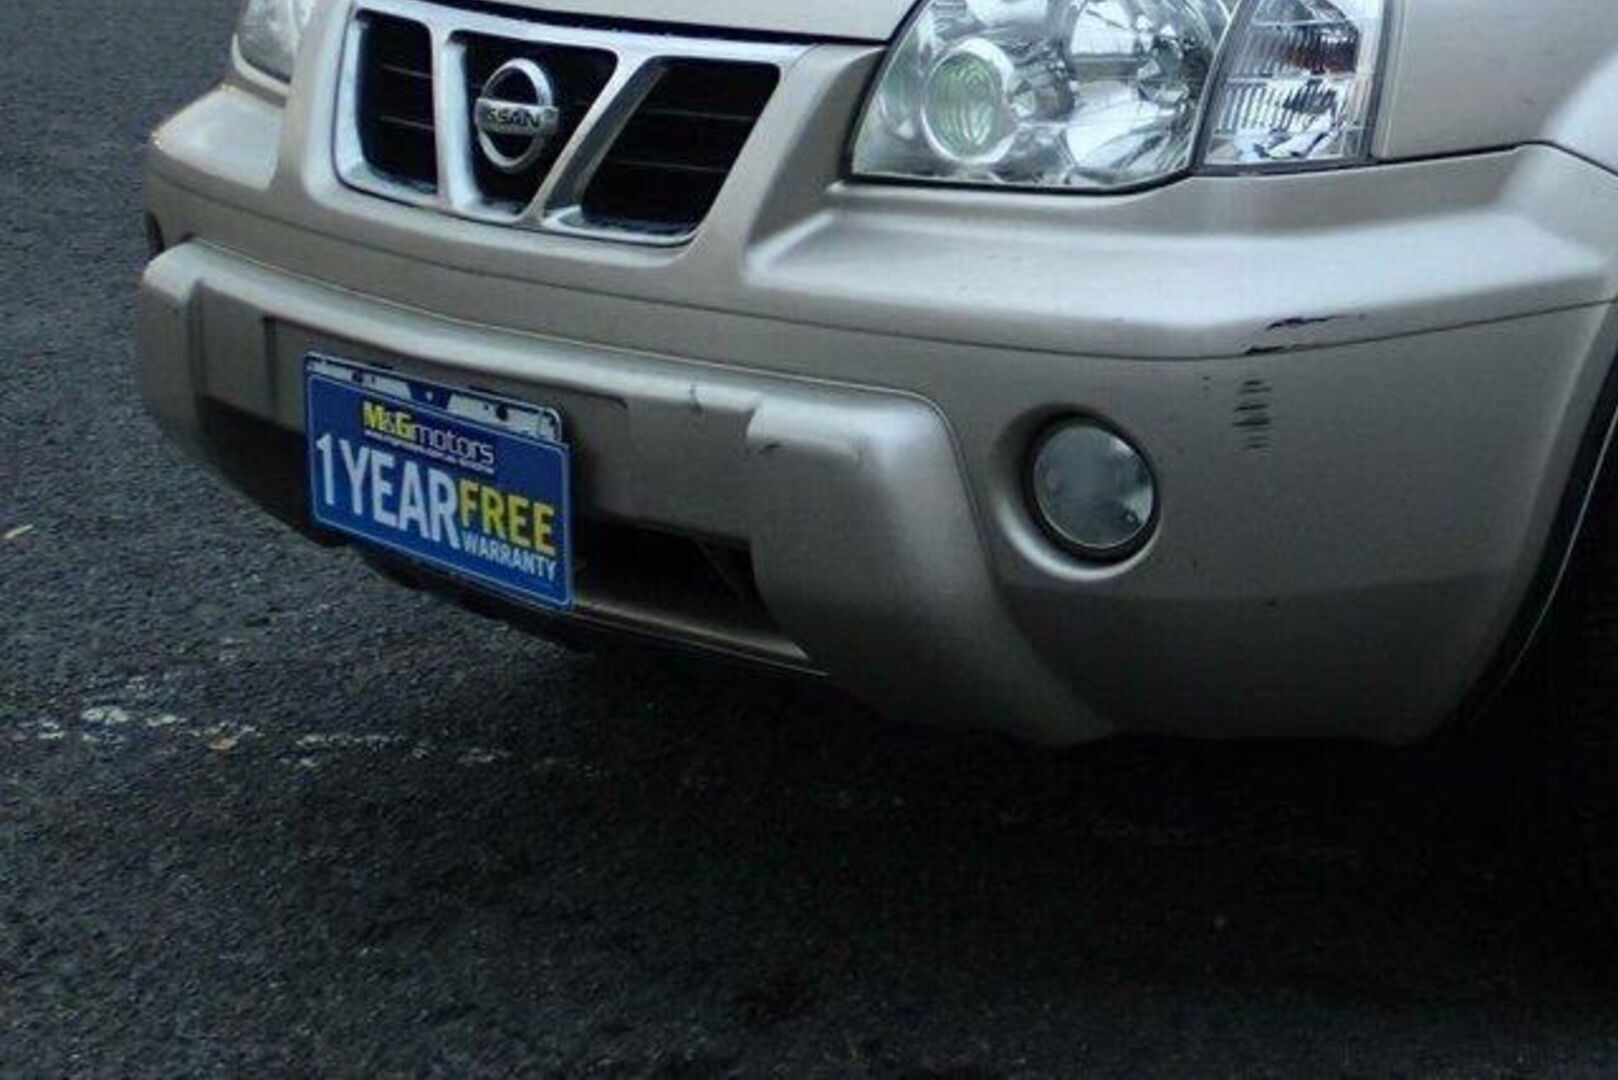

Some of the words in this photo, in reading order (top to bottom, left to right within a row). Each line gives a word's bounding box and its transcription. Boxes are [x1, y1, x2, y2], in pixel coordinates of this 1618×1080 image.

[315, 432, 335, 506] 1
[339, 438, 461, 550] YEAR
[458, 477, 557, 556] FREE
[461, 529, 558, 582] WARRANTY
